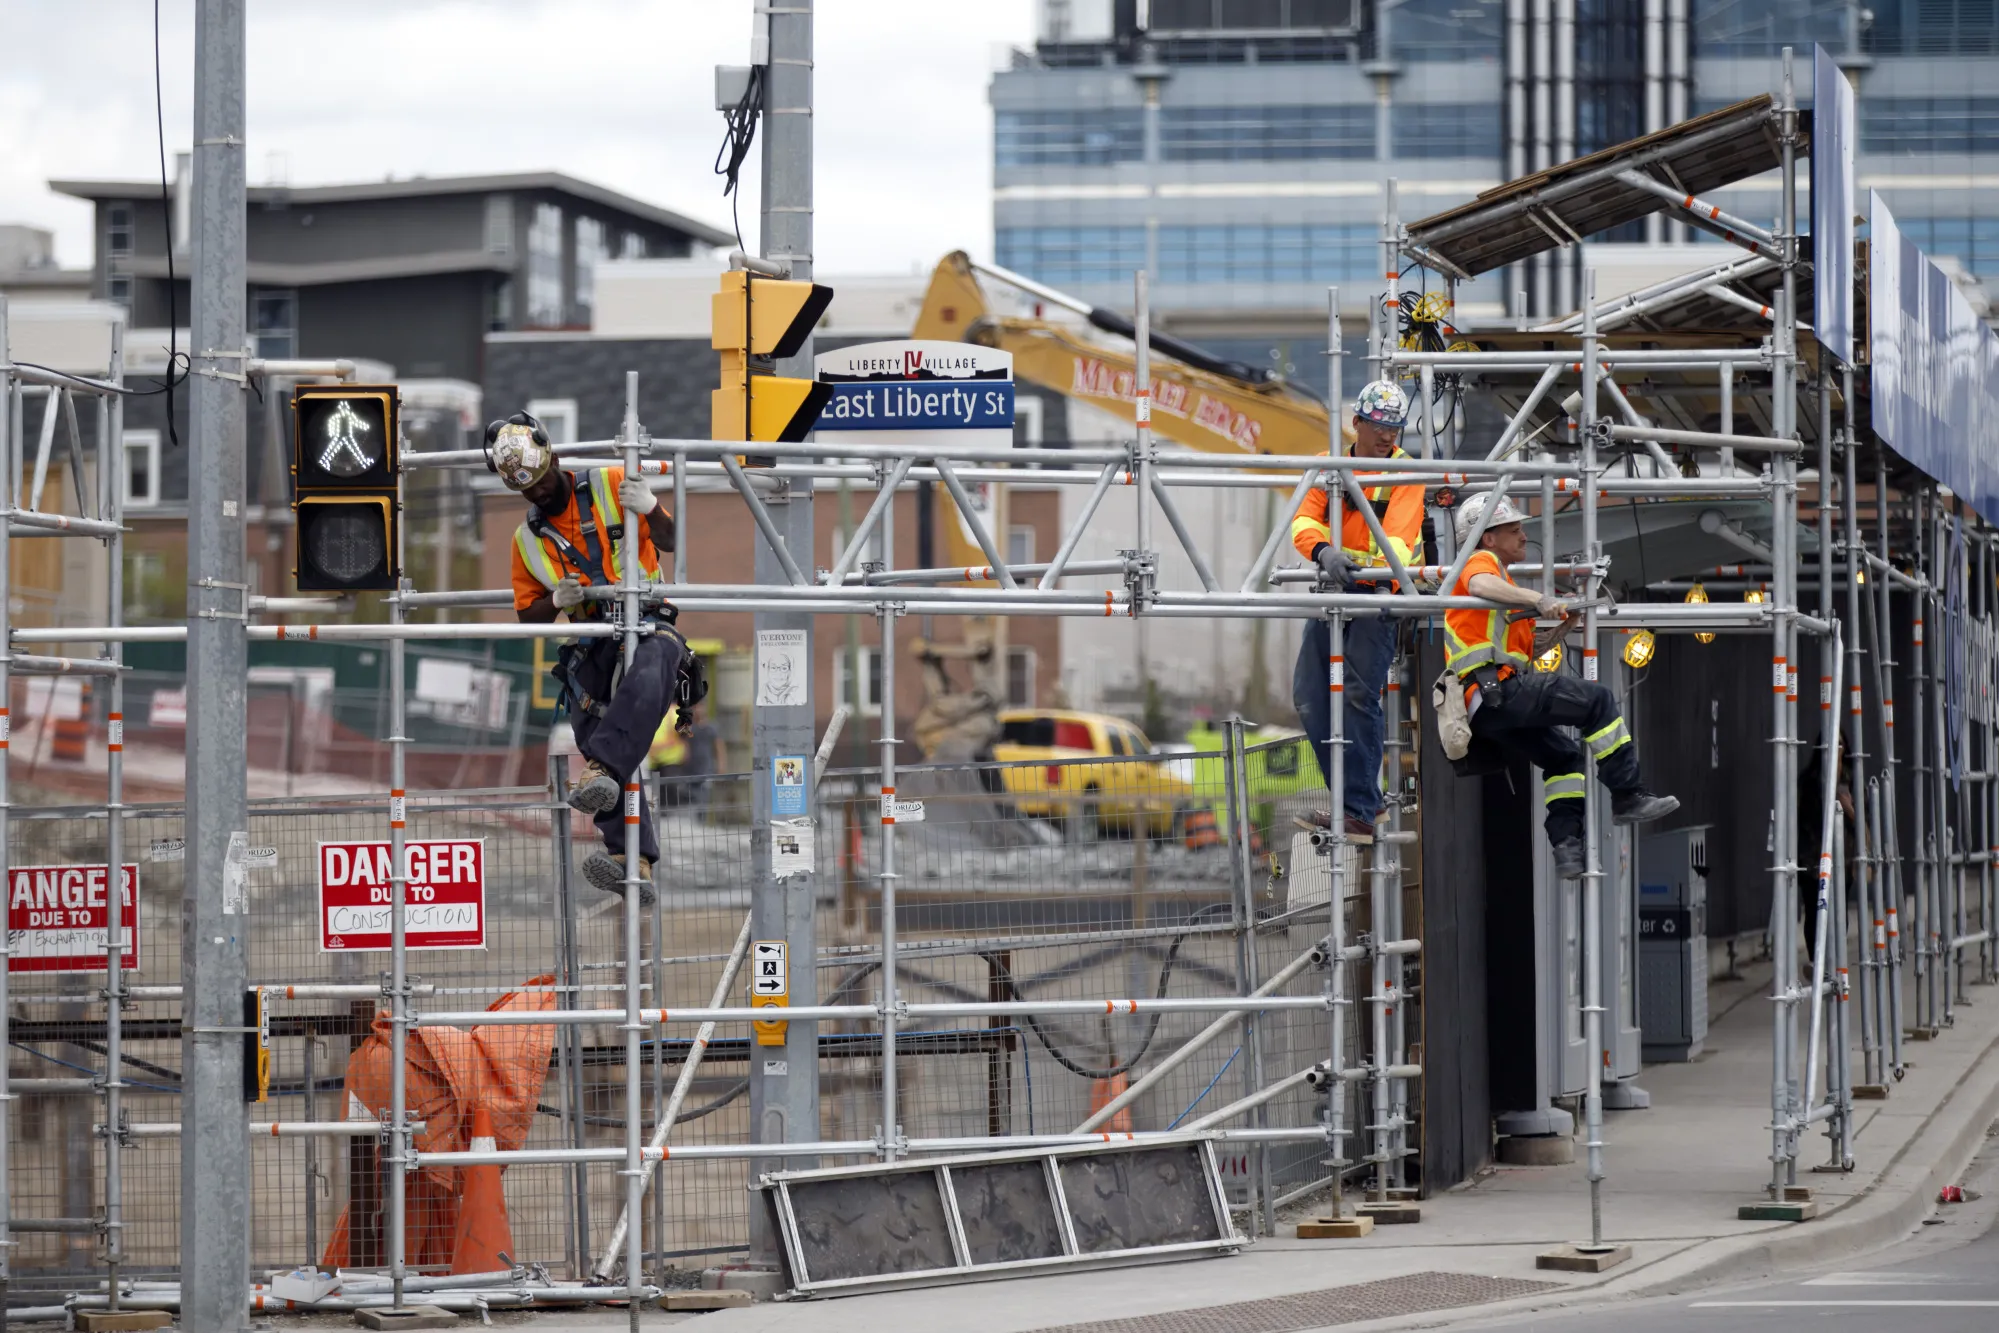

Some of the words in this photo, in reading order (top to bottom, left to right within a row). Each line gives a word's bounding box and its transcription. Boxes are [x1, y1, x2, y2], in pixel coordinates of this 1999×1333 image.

[849, 359, 900, 370] LIBERTY
[925, 358, 977, 369] VILLAGE
[821, 389, 875, 419] East
[884, 387, 977, 423] Liberty
[985, 391, 1006, 415] St
[286, 632, 310, 640] NU-ERA
[896, 803, 922, 812] ORIZON
[325, 844, 477, 886] DANGER
[8, 869, 132, 910] ANGER
[371, 887, 406, 902] DU
[411, 886, 435, 902] TO
[30, 911, 64, 927] DUE
[69, 910, 92, 925] TO
[334, 904, 472, 932] CONSTUCTION
[8, 931, 26, 945] EP
